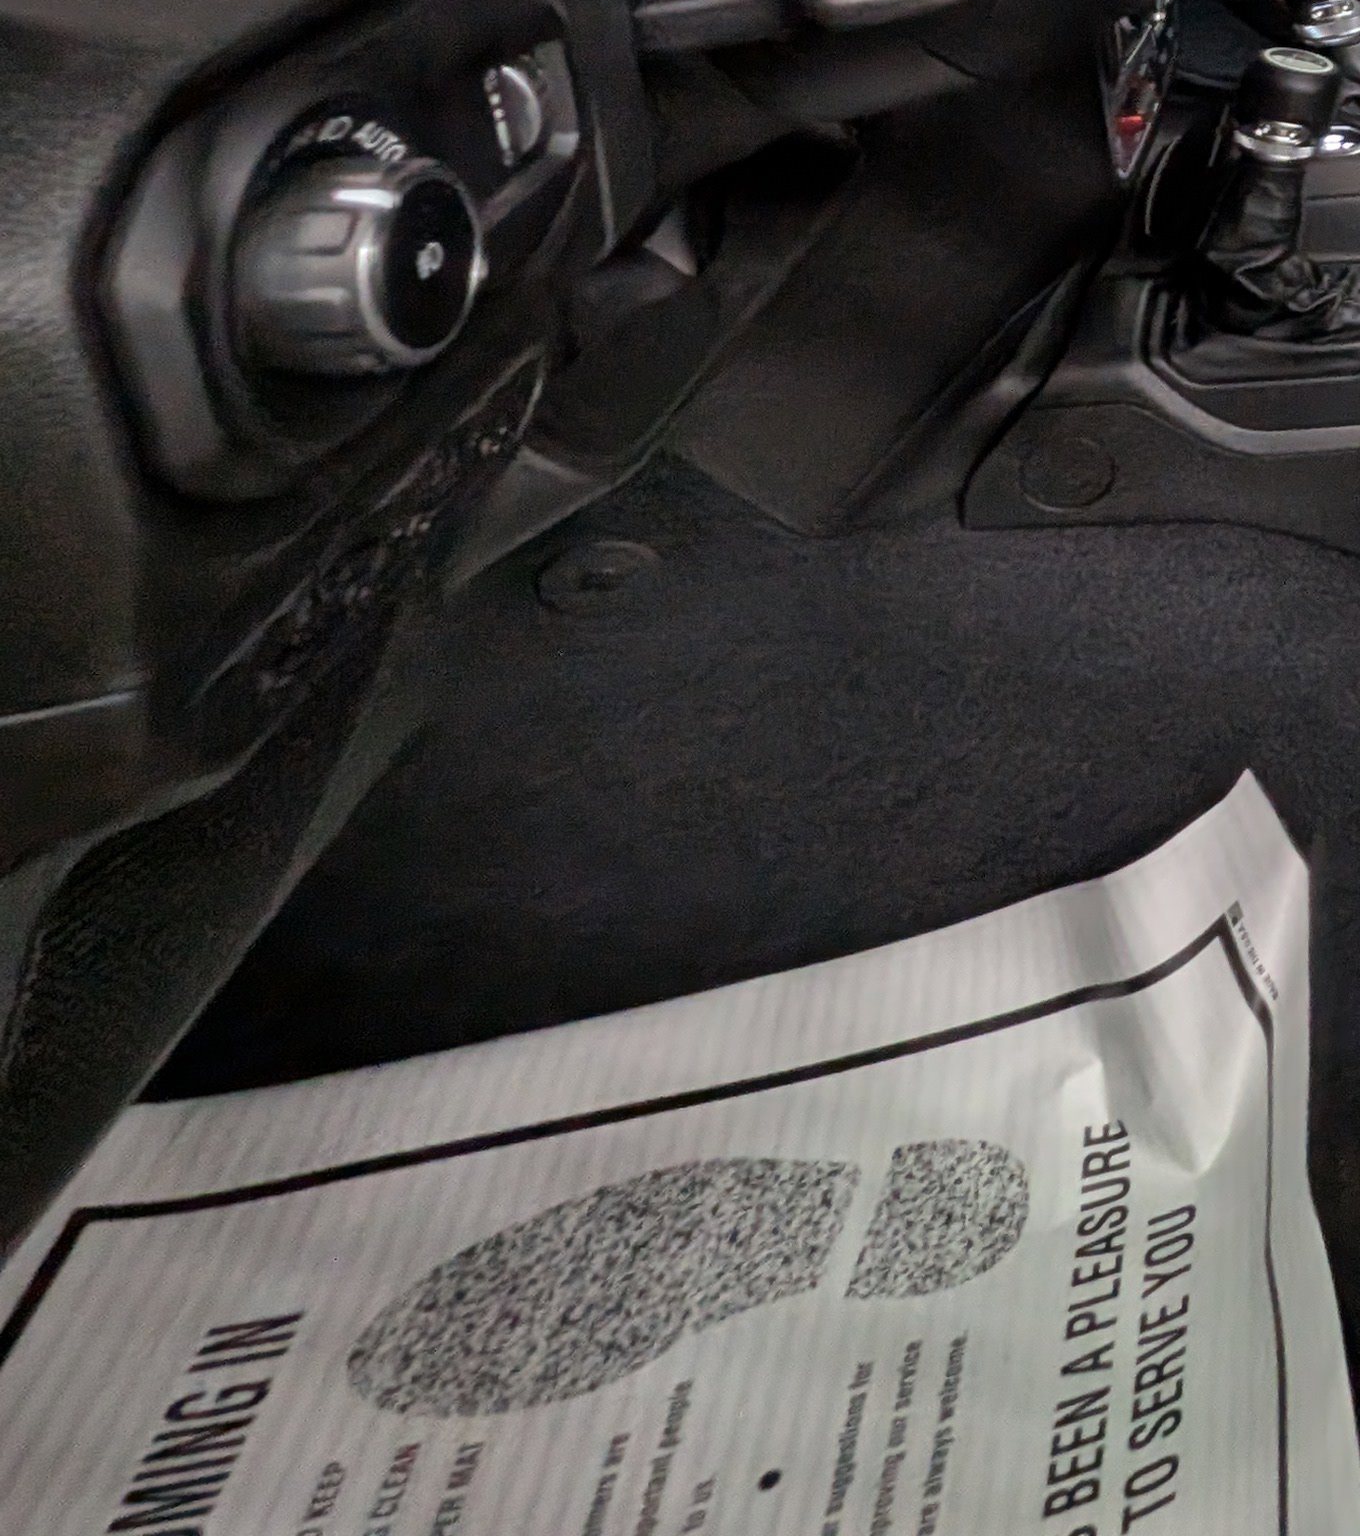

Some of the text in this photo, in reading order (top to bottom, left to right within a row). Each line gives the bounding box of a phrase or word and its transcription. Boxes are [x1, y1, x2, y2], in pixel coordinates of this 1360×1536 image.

[352, 121, 408, 162] AUTO
[1064, 1118, 1132, 1342] PLEASURE
[894, 1337, 924, 1412] service
[1059, 1340, 1117, 1377] A
[1120, 1202, 1198, 1536] TO SERVE YOU
[106, 1310, 305, 1536] MING IN
[604, 1432, 631, 1467] are
[825, 1391, 868, 1518] suggestions
[847, 1360, 875, 1391] for
[887, 1415, 908, 1449] our
[1041, 1384, 1112, 1521] BEEN
[303, 1461, 348, 1522] KEEP
[368, 1441, 422, 1520] CLEAN
[446, 1440, 486, 1490] MAT
[922, 1425, 956, 1499] always
